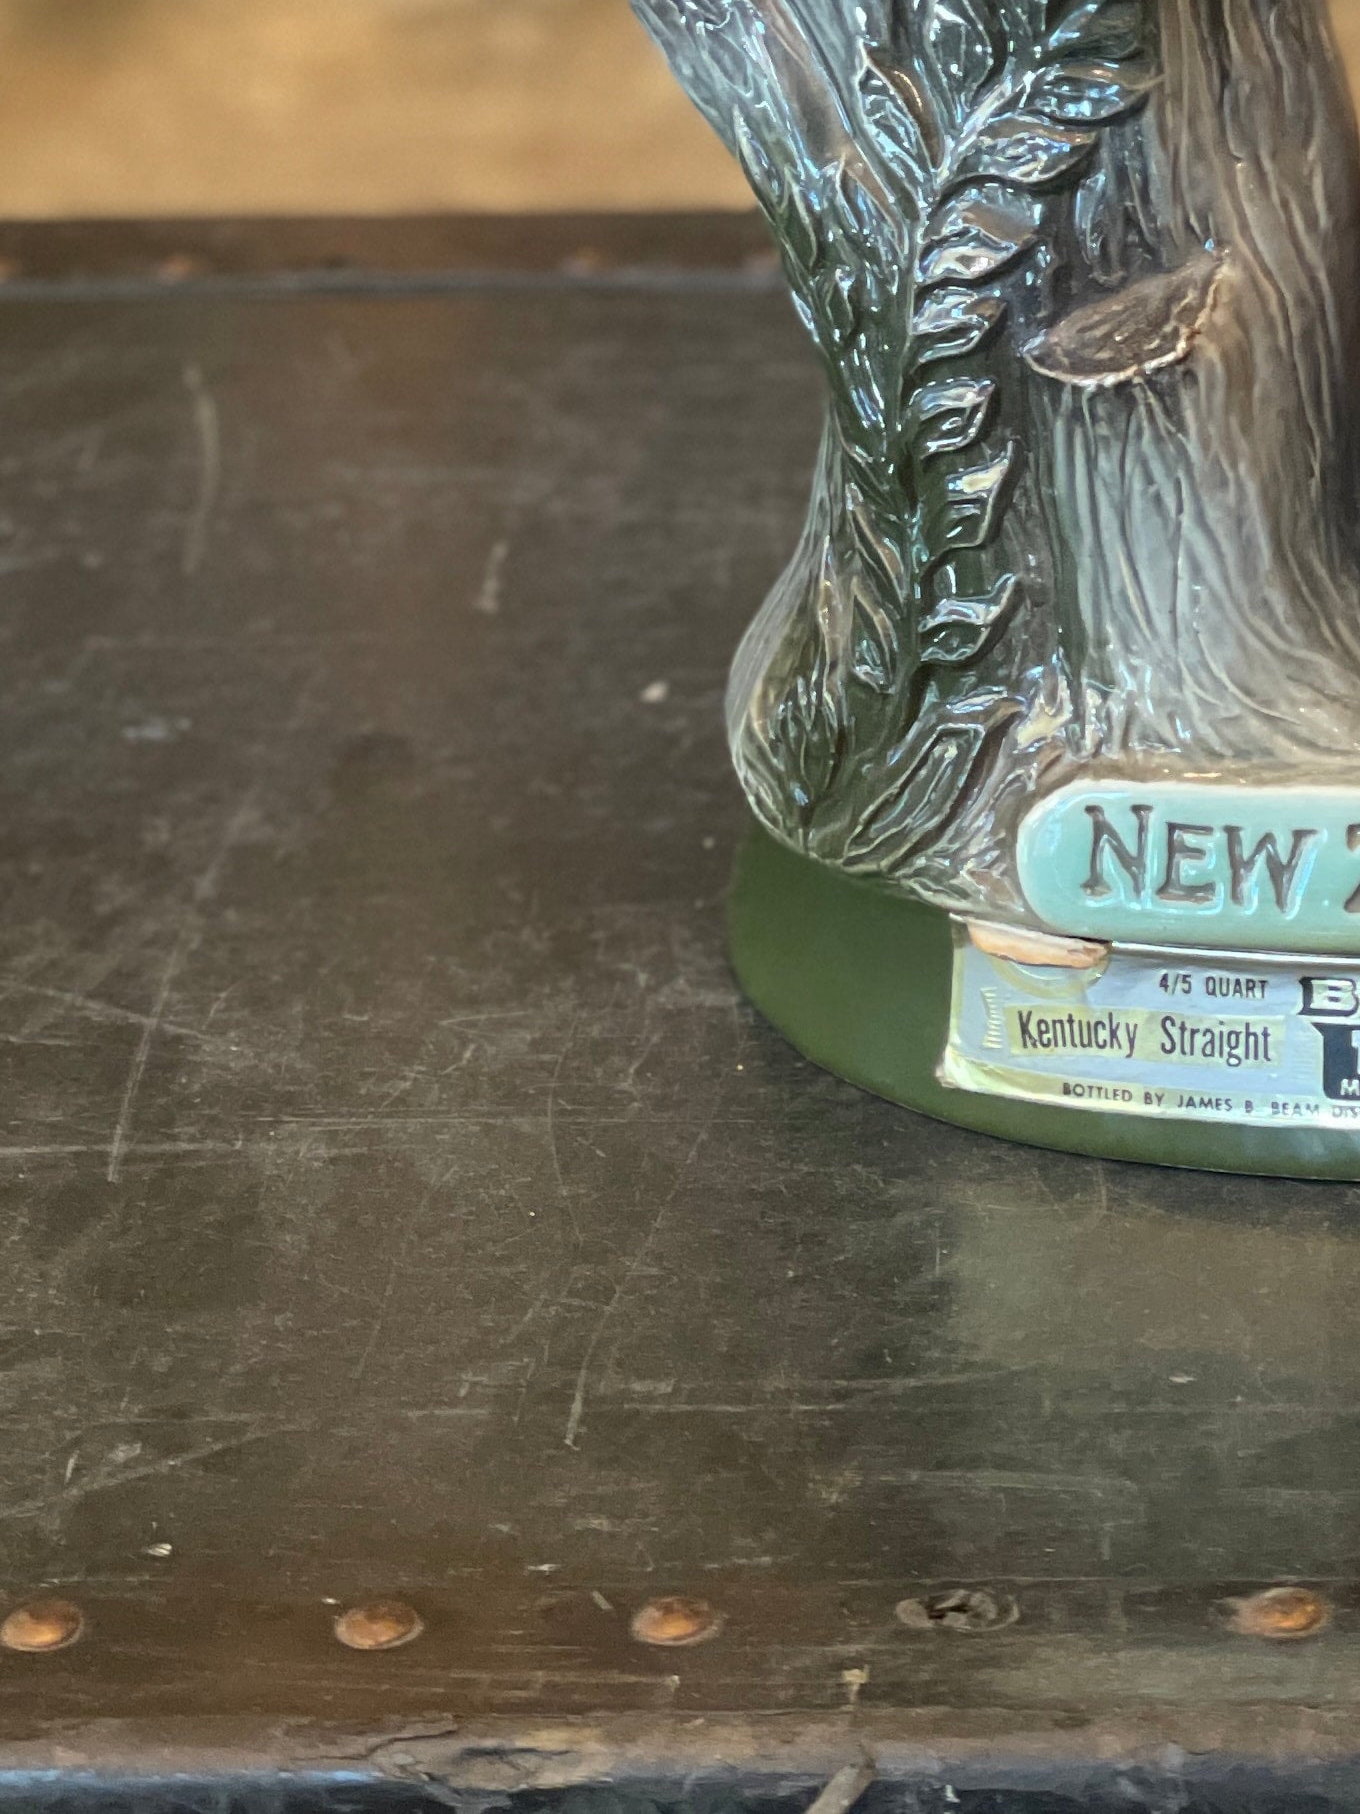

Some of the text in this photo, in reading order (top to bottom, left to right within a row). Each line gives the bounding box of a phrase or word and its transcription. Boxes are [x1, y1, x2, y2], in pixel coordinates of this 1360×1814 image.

[1082, 803, 1318, 912] NEW
[1158, 972, 1269, 1000] 4/5 QUART
[1017, 1010, 1272, 1068] Kentucky Straight
[1062, 1082, 1133, 1103] BOTTLED
[1143, 1090, 1166, 1108] BY
[1177, 1094, 1233, 1113] JAMES
[1270, 1100, 1320, 1117] BEAM
